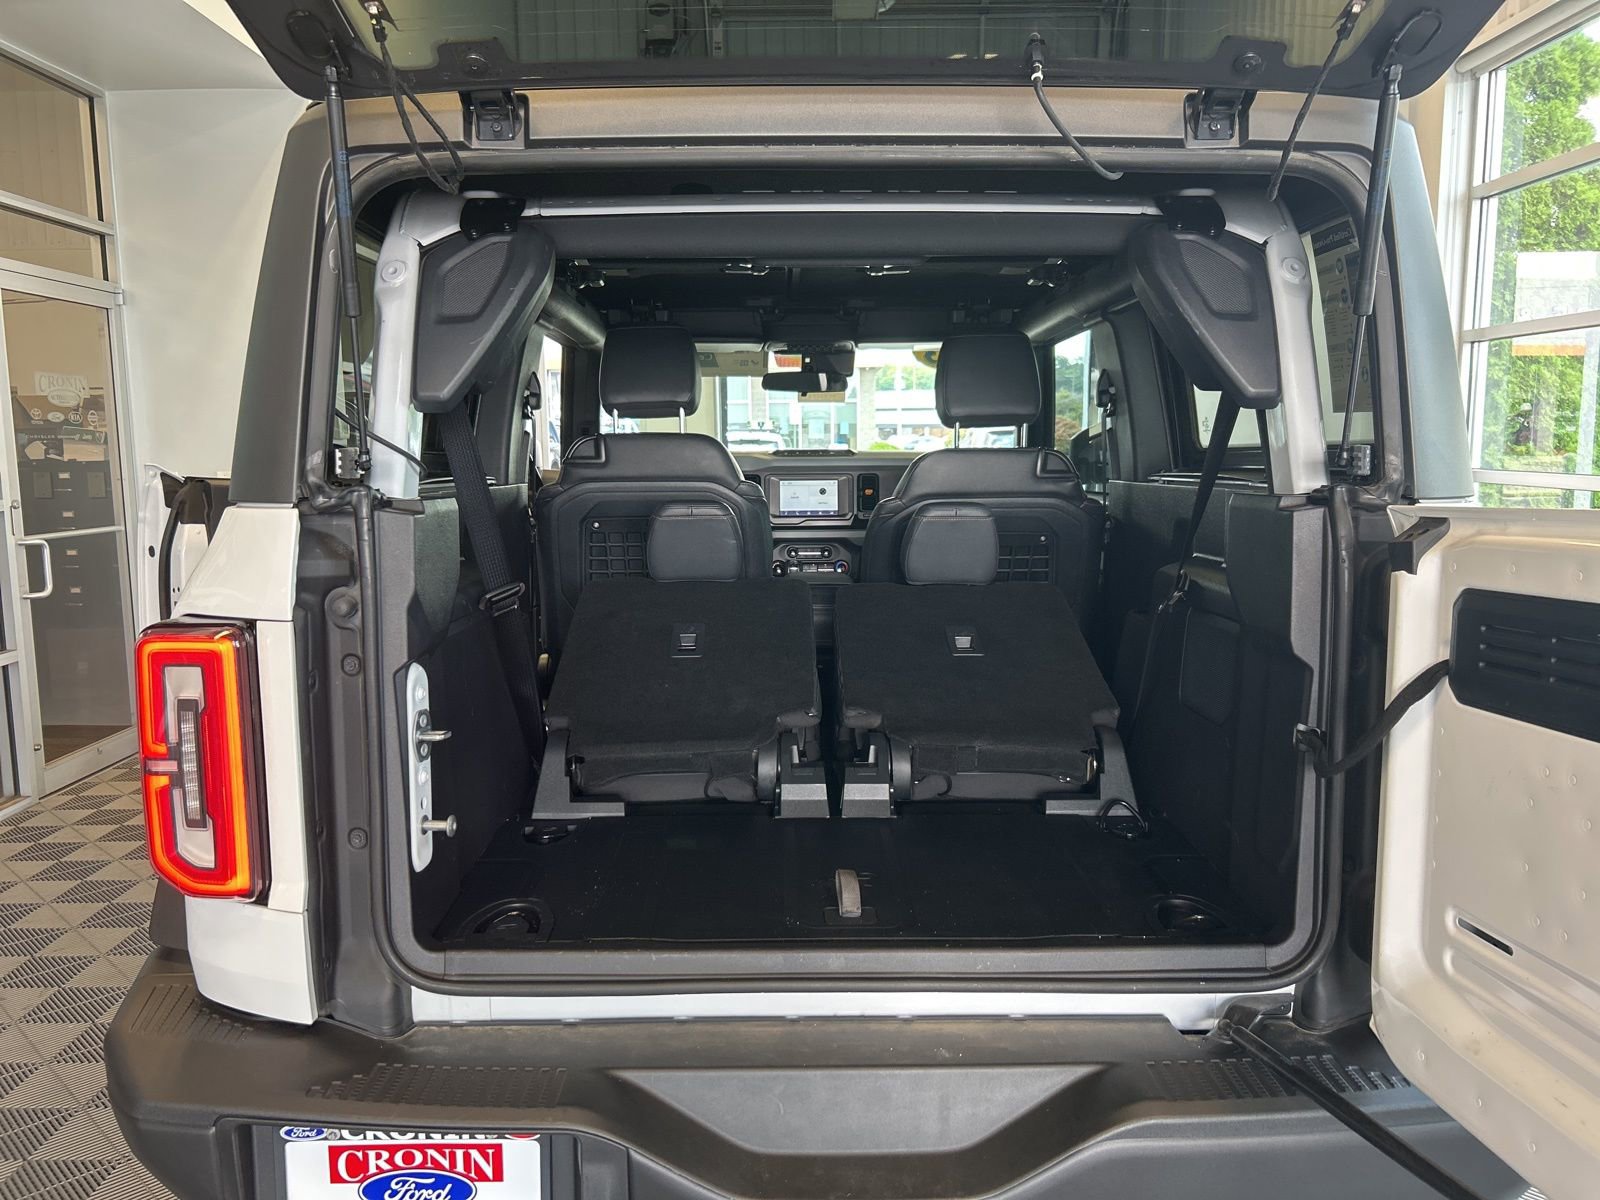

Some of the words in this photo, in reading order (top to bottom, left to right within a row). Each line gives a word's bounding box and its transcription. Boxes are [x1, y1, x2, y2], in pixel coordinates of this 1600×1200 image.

[39, 374, 86, 392] CRONIN
[291, 1127, 318, 1138] Ford
[337, 1148, 495, 1181] CRONIN
[384, 1177, 452, 1200] Ford
